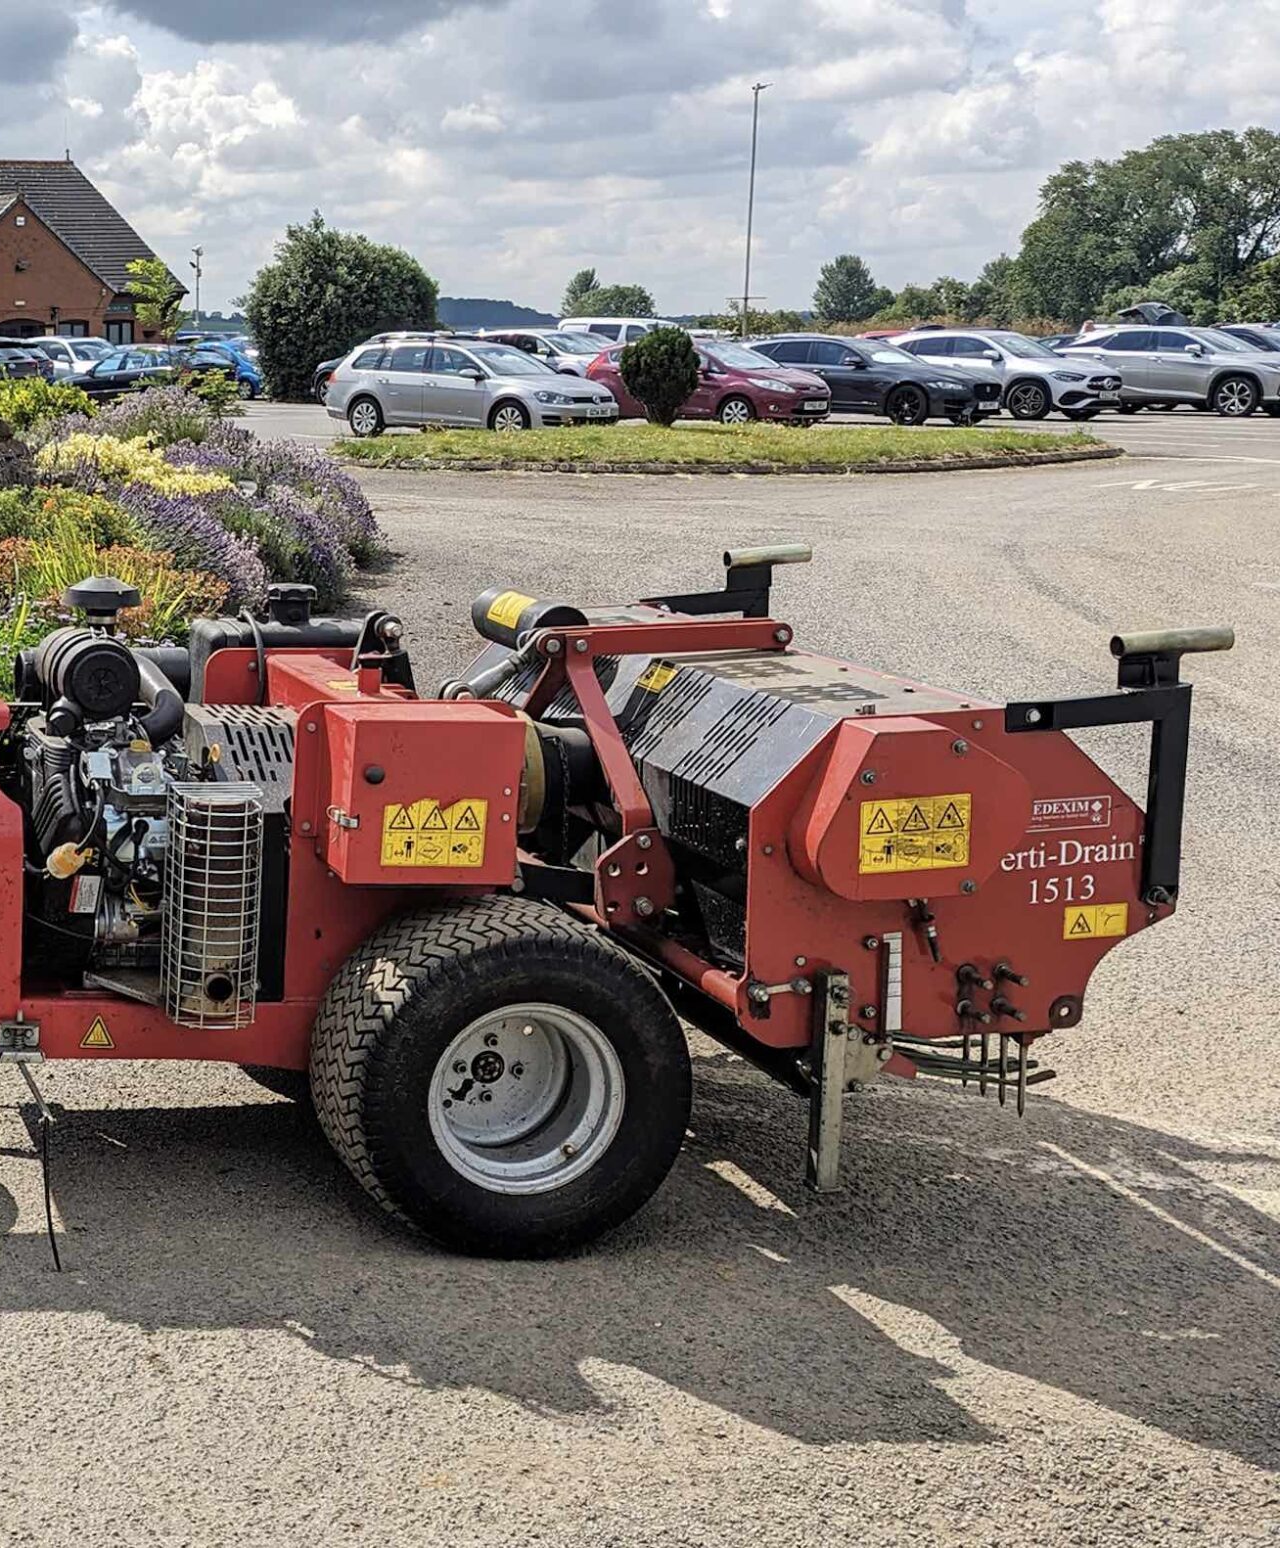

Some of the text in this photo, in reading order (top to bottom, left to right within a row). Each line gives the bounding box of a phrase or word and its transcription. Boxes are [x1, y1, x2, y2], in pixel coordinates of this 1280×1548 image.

[1033, 801, 1090, 815] EDEXIM
[1000, 835, 1136, 872] erti-Drain
[1029, 874, 1096, 905] 1513
